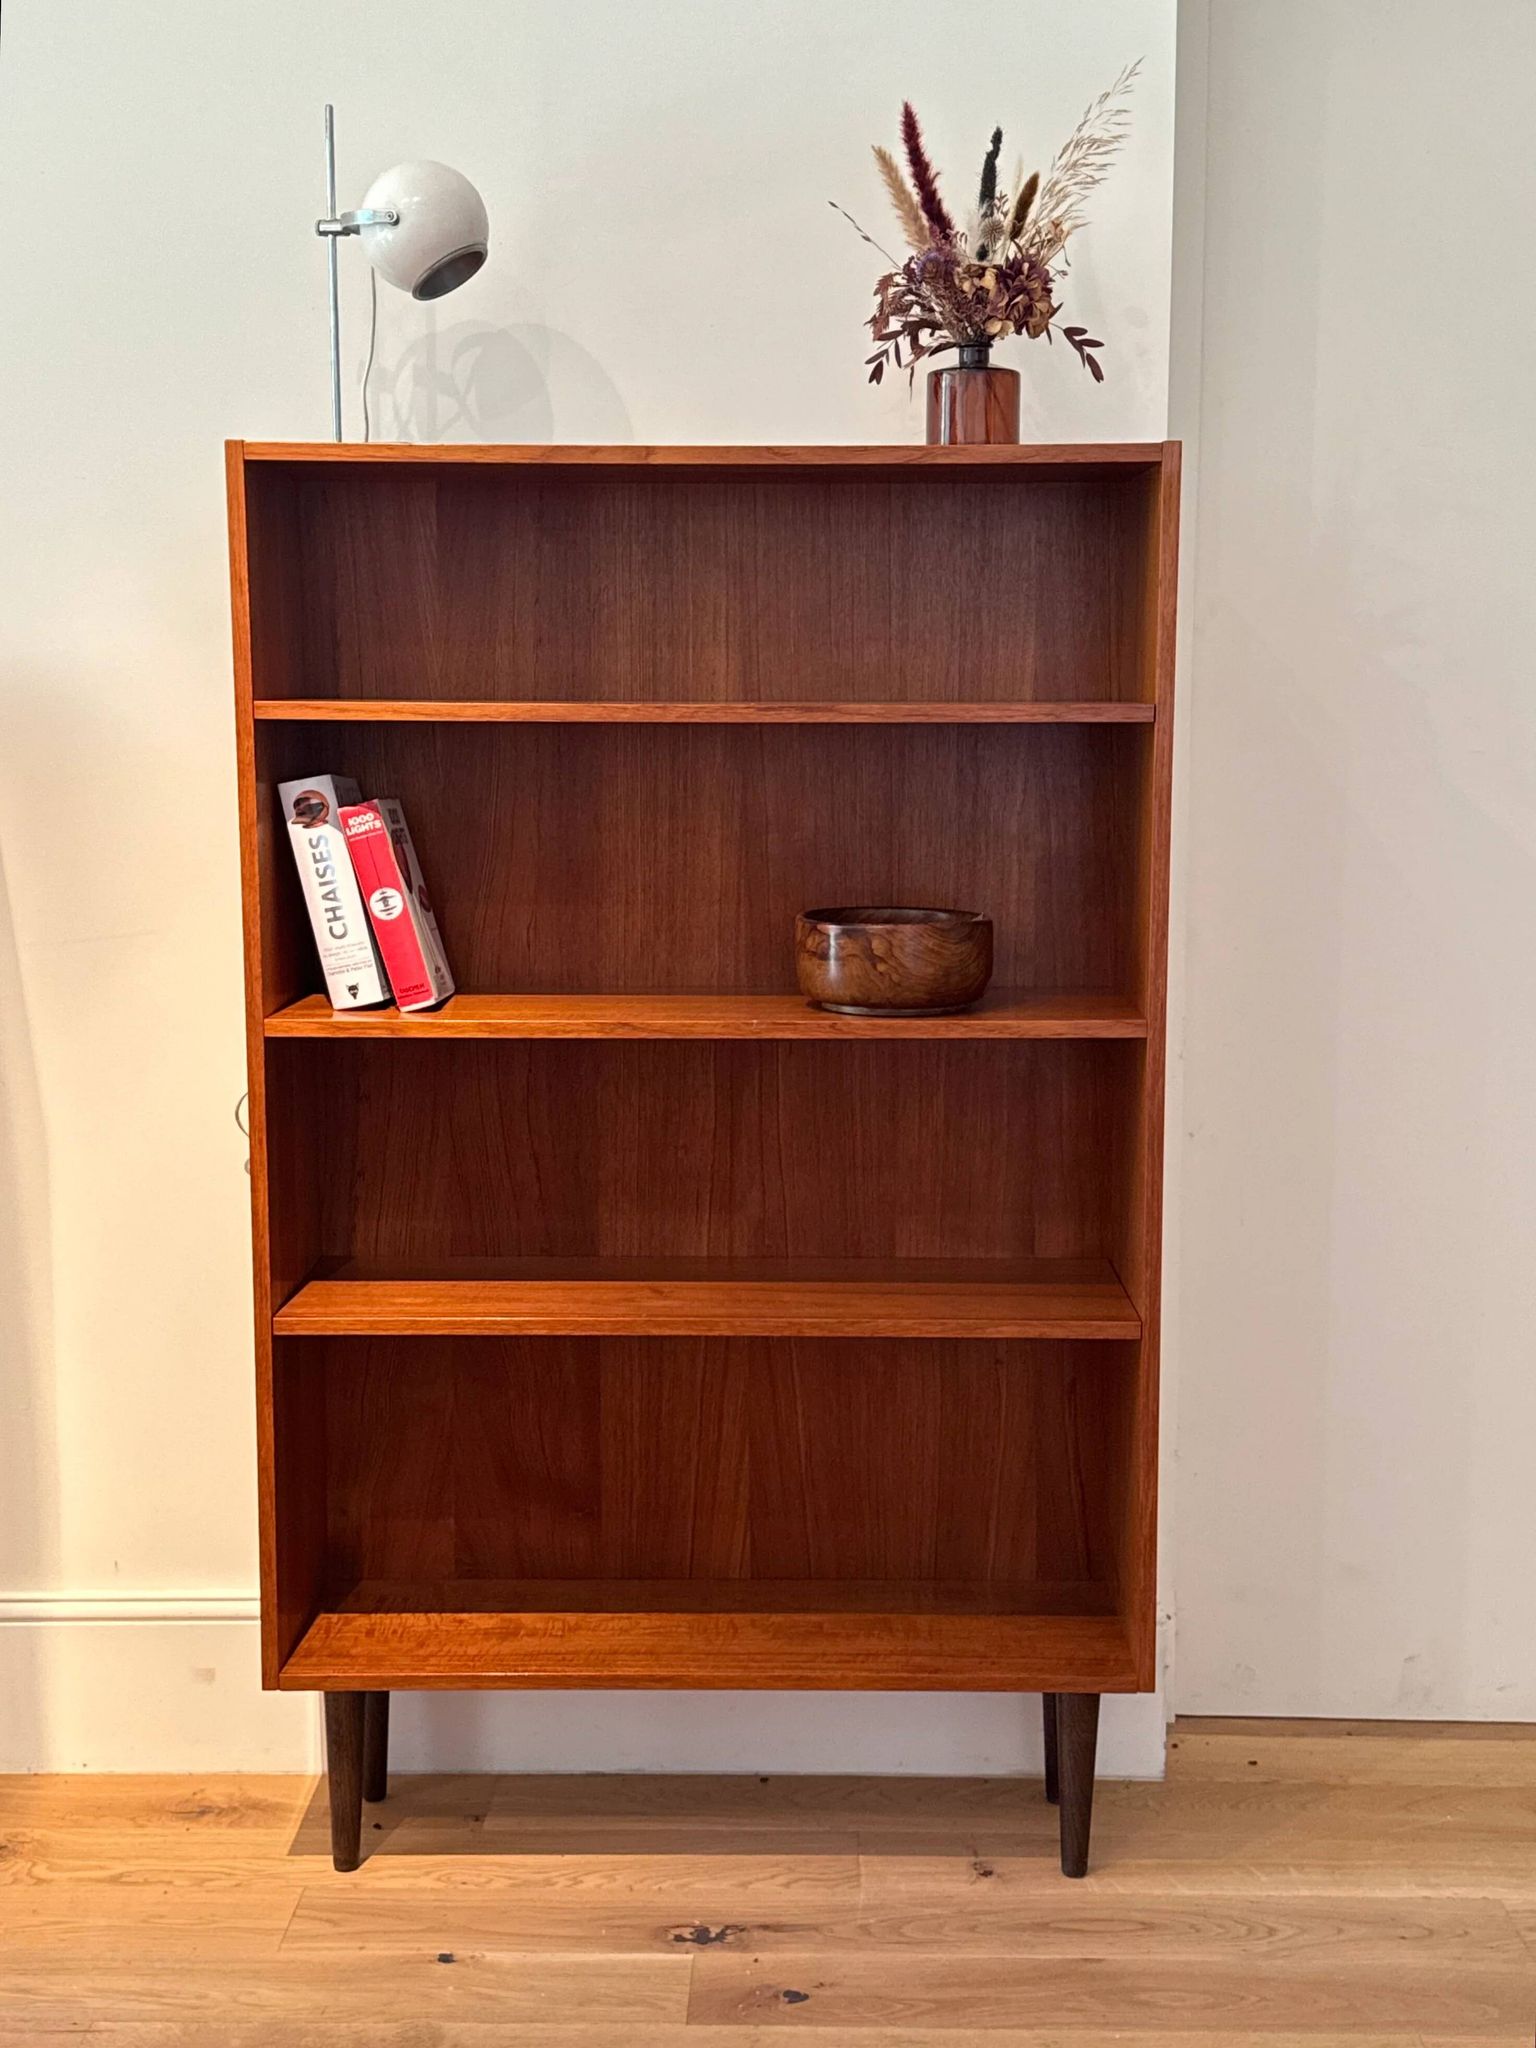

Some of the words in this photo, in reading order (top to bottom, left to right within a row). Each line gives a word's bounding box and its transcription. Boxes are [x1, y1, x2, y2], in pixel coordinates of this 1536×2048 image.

[346, 819, 382, 836] LIGHTS
[348, 812, 374, 826] 1000
[308, 834, 348, 940] CHAISES
